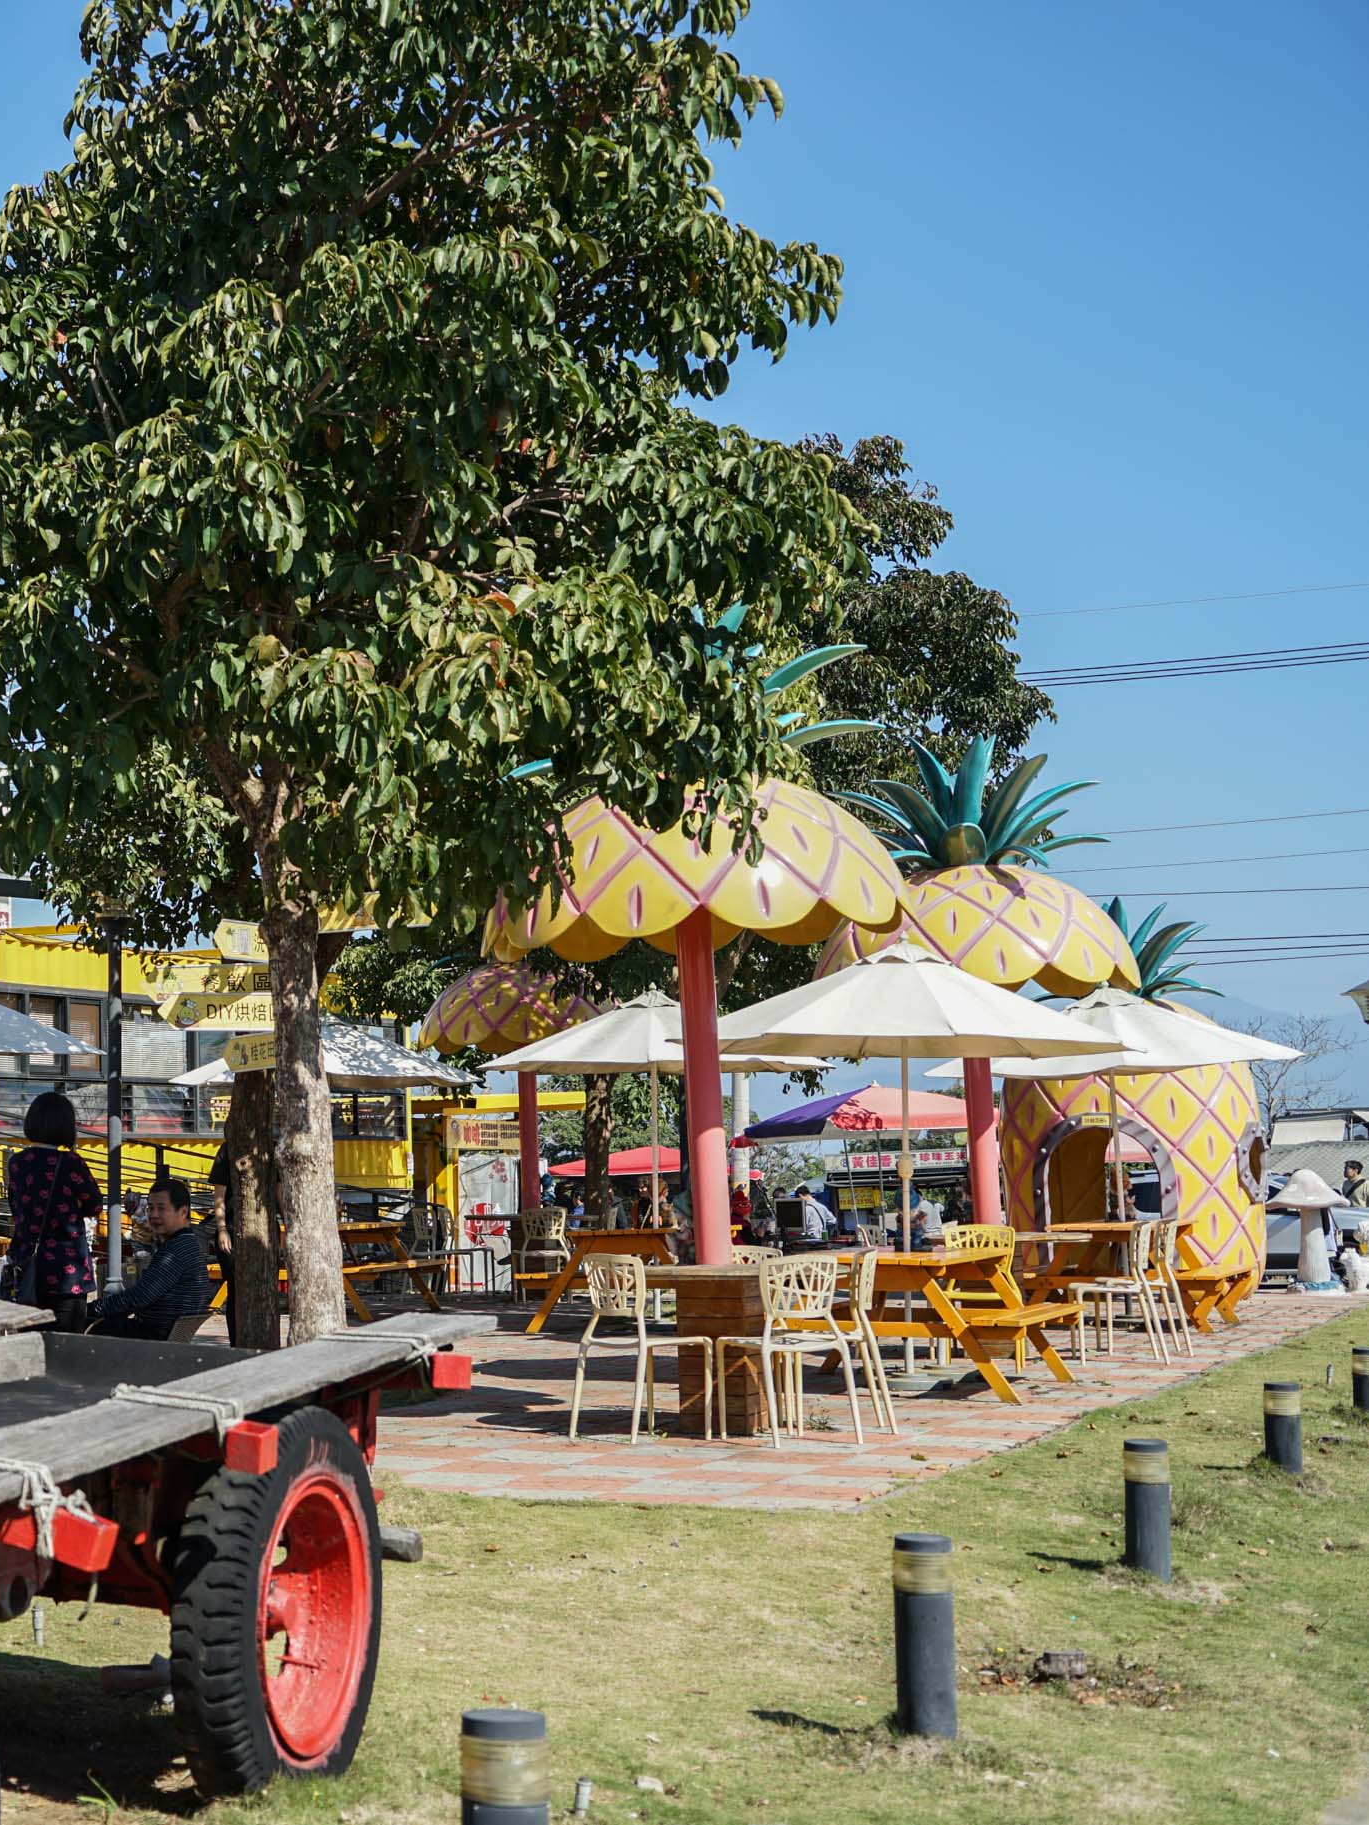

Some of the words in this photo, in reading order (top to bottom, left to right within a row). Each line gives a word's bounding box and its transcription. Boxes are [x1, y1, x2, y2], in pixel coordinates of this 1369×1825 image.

[201, 973, 271, 994] 餐飲區
[206, 1002, 275, 1022] DIY烘焙
